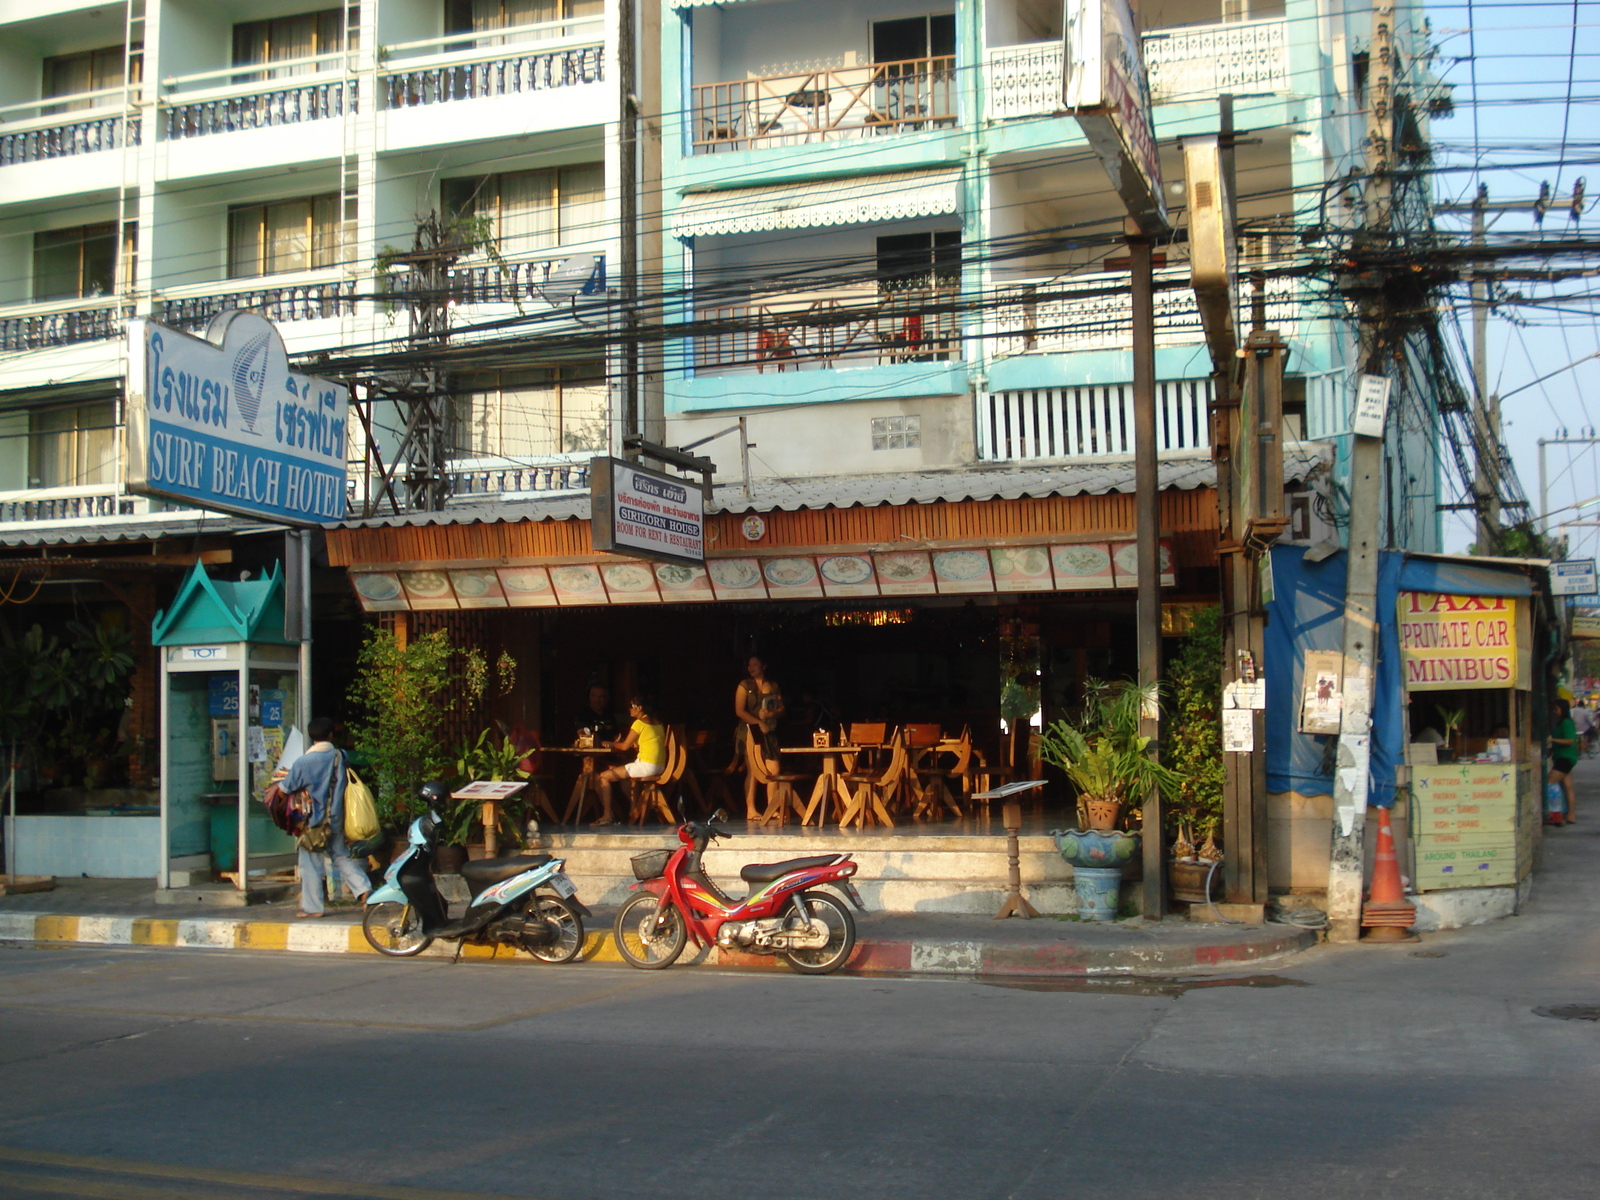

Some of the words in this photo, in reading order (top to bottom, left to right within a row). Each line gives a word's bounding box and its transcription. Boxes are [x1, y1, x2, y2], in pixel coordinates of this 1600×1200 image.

[151, 331, 229, 429] โรงแรม
[151, 430, 206, 490] SURF
[211, 445, 282, 504] BEACH
[284, 463, 344, 520] HOTEL
[621, 508, 667, 529] SIRIKORN
[669, 520, 699, 536] HOUSE
[616, 521, 634, 535] ROOM
[635, 526, 647, 539] FOR
[648, 530, 662, 542] RENT
[664, 534, 669, 544] &
[669, 534, 702, 551] RESTAURANT
[1567, 577, 1589, 585] ROOMS
[1577, 584, 1593, 592] RENT
[1401, 591, 1508, 613] TAXI
[1402, 621, 1472, 650] PRIVATE
[1475, 620, 1510, 647] CAR
[188, 648, 221, 658] TOT
[1407, 657, 1510, 683] MINIBUS
[223, 697, 238, 710] 25
[269, 707, 280, 721] 25
[1424, 852, 1456, 861] AROUND
[1461, 850, 1498, 859] THAILAND
